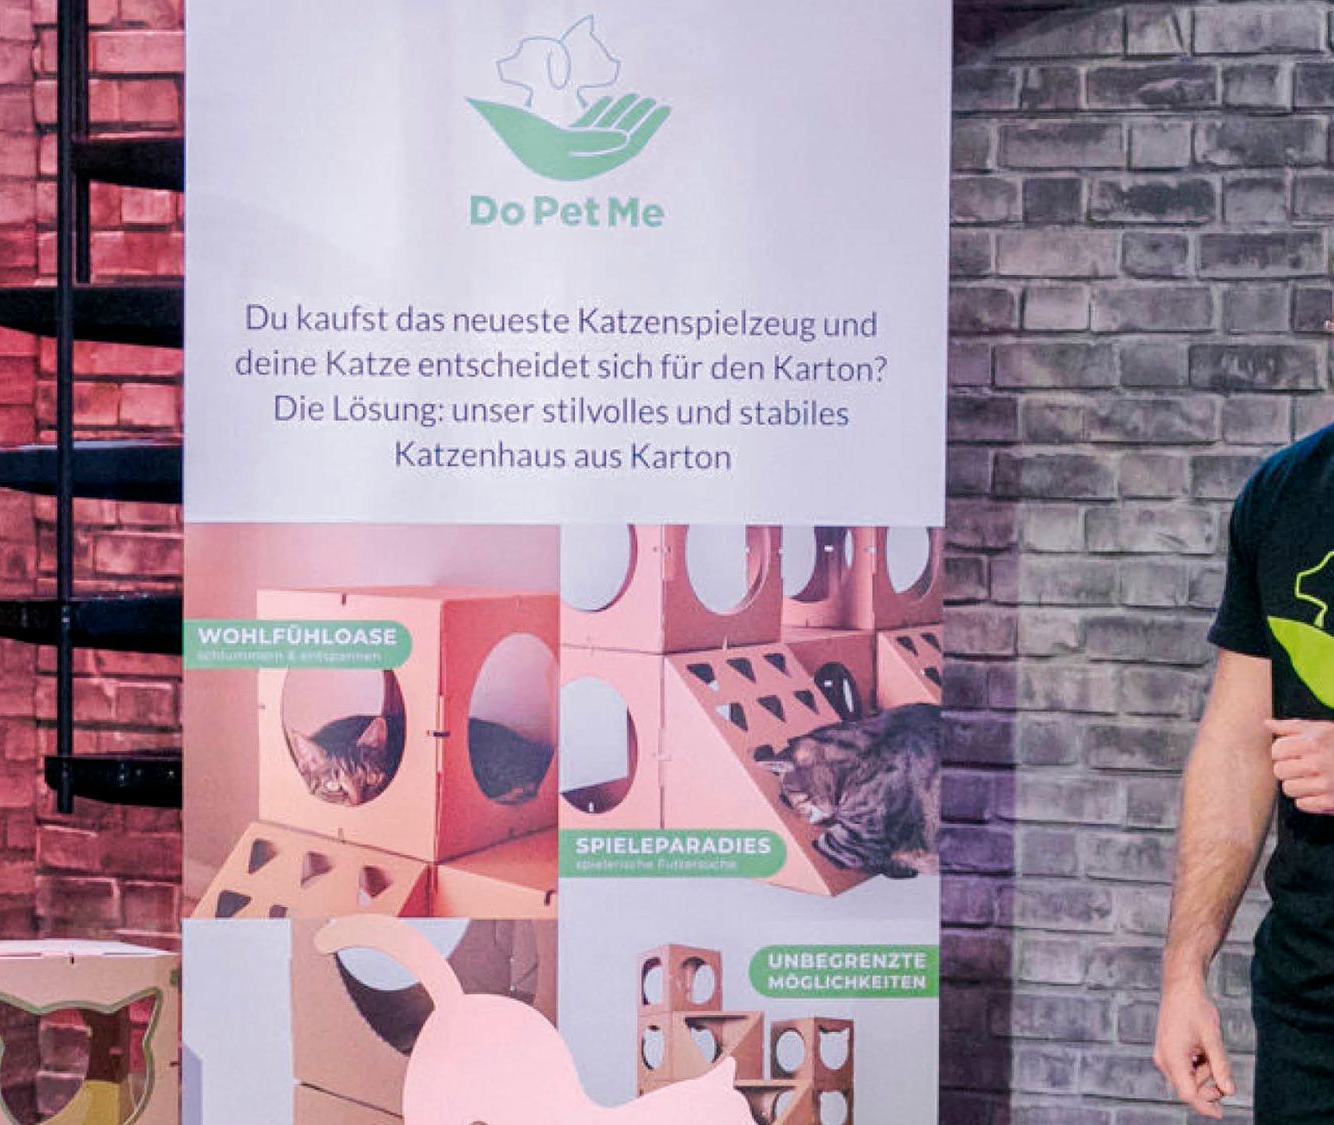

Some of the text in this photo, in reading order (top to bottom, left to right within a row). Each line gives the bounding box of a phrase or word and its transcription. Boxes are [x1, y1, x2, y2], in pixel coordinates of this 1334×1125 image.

[469, 194, 666, 228] Do Pet Me
[246, 303, 877, 343] Du kaufst das neueste Katzenspielzeug und
[235, 348, 888, 383] deine Katze entscheidet sich für den Karton?
[274, 394, 850, 429] Die Lösung: unser stilvolles und stabiles
[395, 440, 732, 471] Katzenhaus aus Karton
[197, 624, 398, 646] WOHLFÜHLOASE
[576, 837, 772, 854] SPIELEPARADIES
[768, 952, 927, 969] UNBEGRENZTE
[768, 973, 927, 989] MÖGLICHKEITEN
